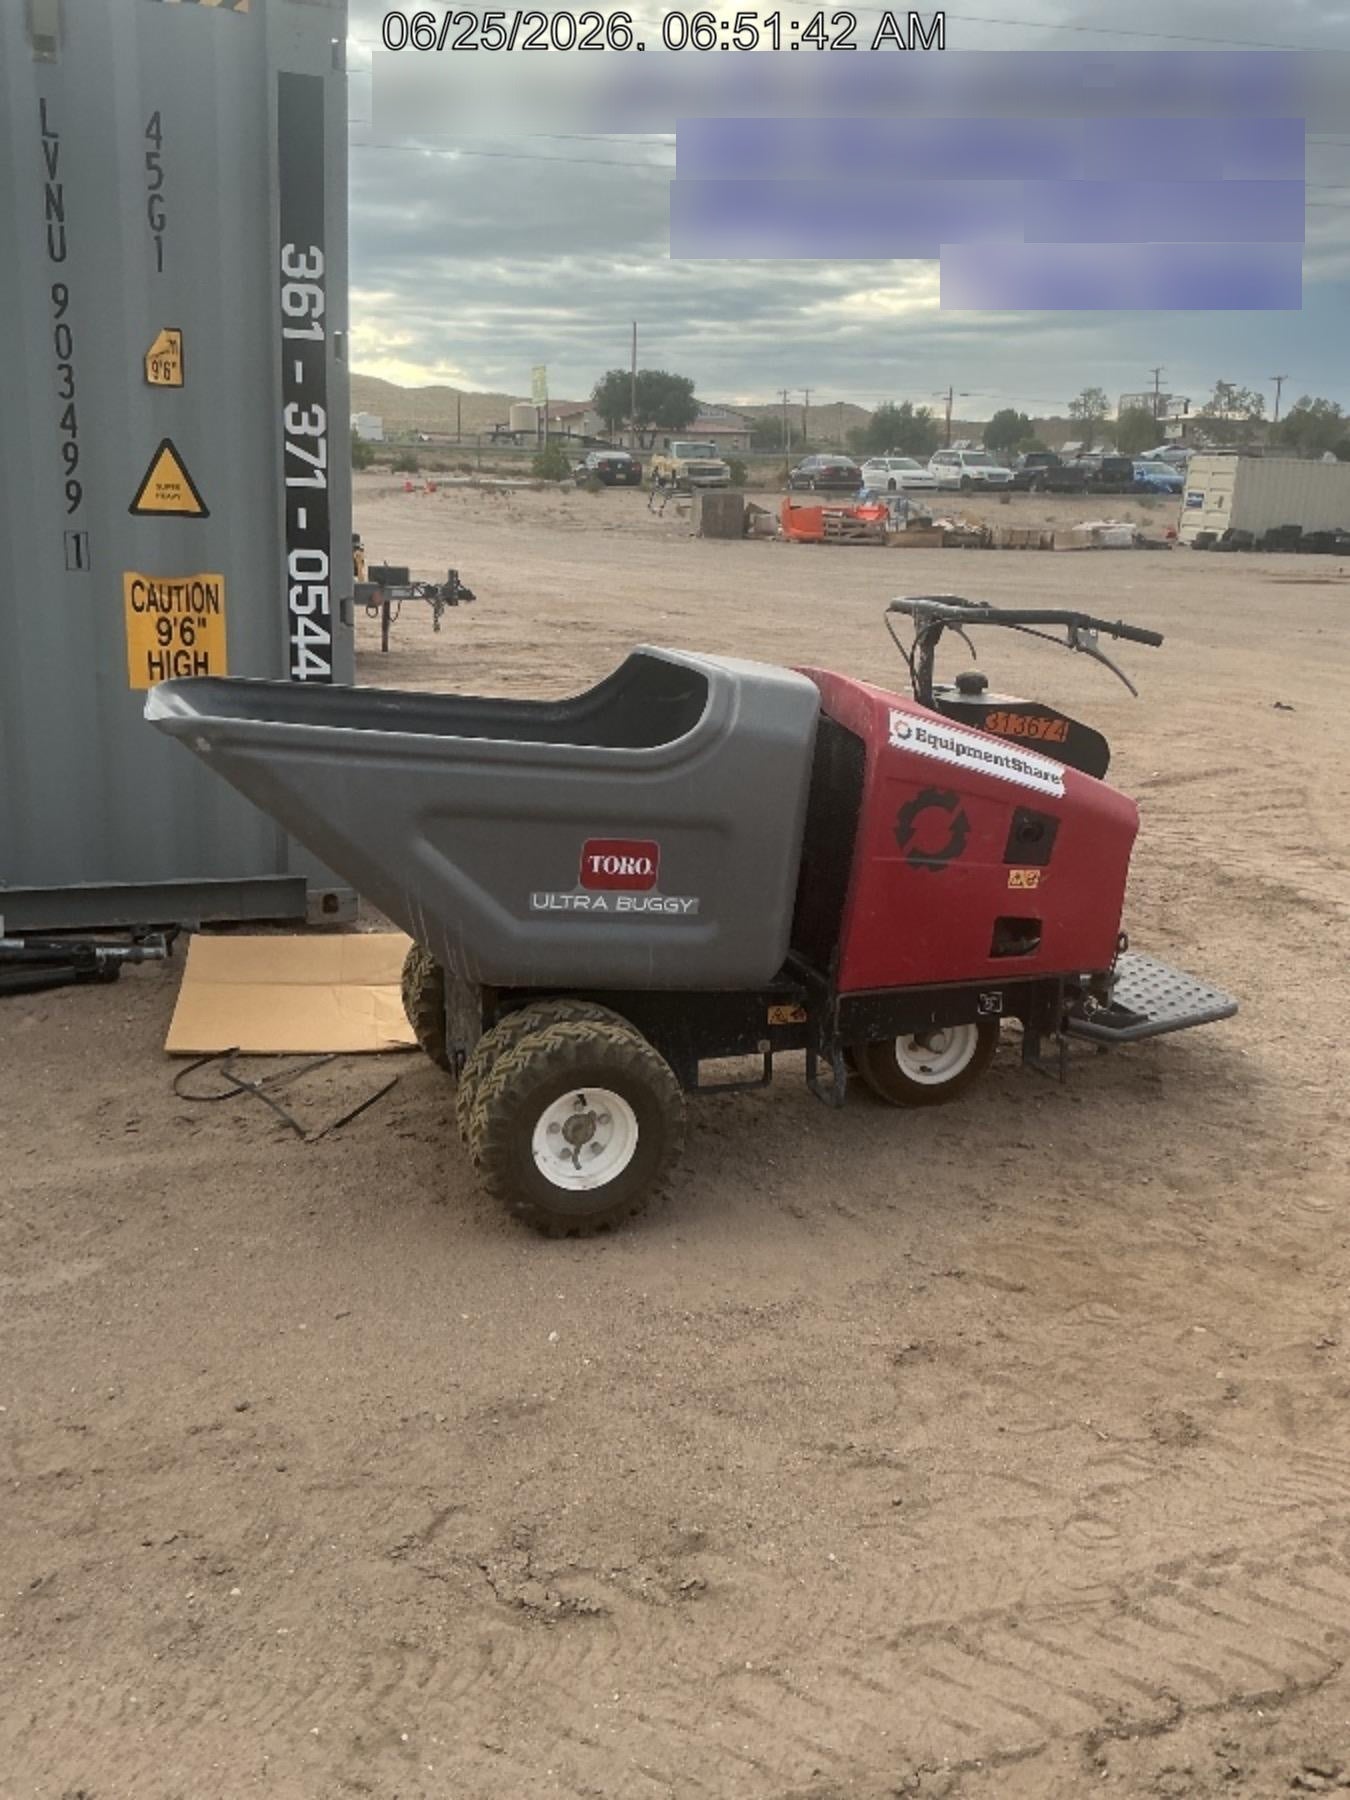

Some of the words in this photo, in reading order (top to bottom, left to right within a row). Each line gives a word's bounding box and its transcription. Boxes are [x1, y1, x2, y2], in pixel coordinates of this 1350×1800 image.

[40, 97, 67, 263] LVNU
[145, 111, 166, 272] 45G1
[51, 283, 83, 514] 903499
[71, 533, 83, 569] 1
[131, 580, 219, 614] CAUTION
[156, 617, 207, 646] 9'6"
[147, 650, 209, 681] HIGH
[914, 726, 1062, 786] EquipmentShare
[588, 855, 653, 875] TORO
[532, 895, 609, 910] ULTRA
[615, 897, 694, 913] BUGGY
